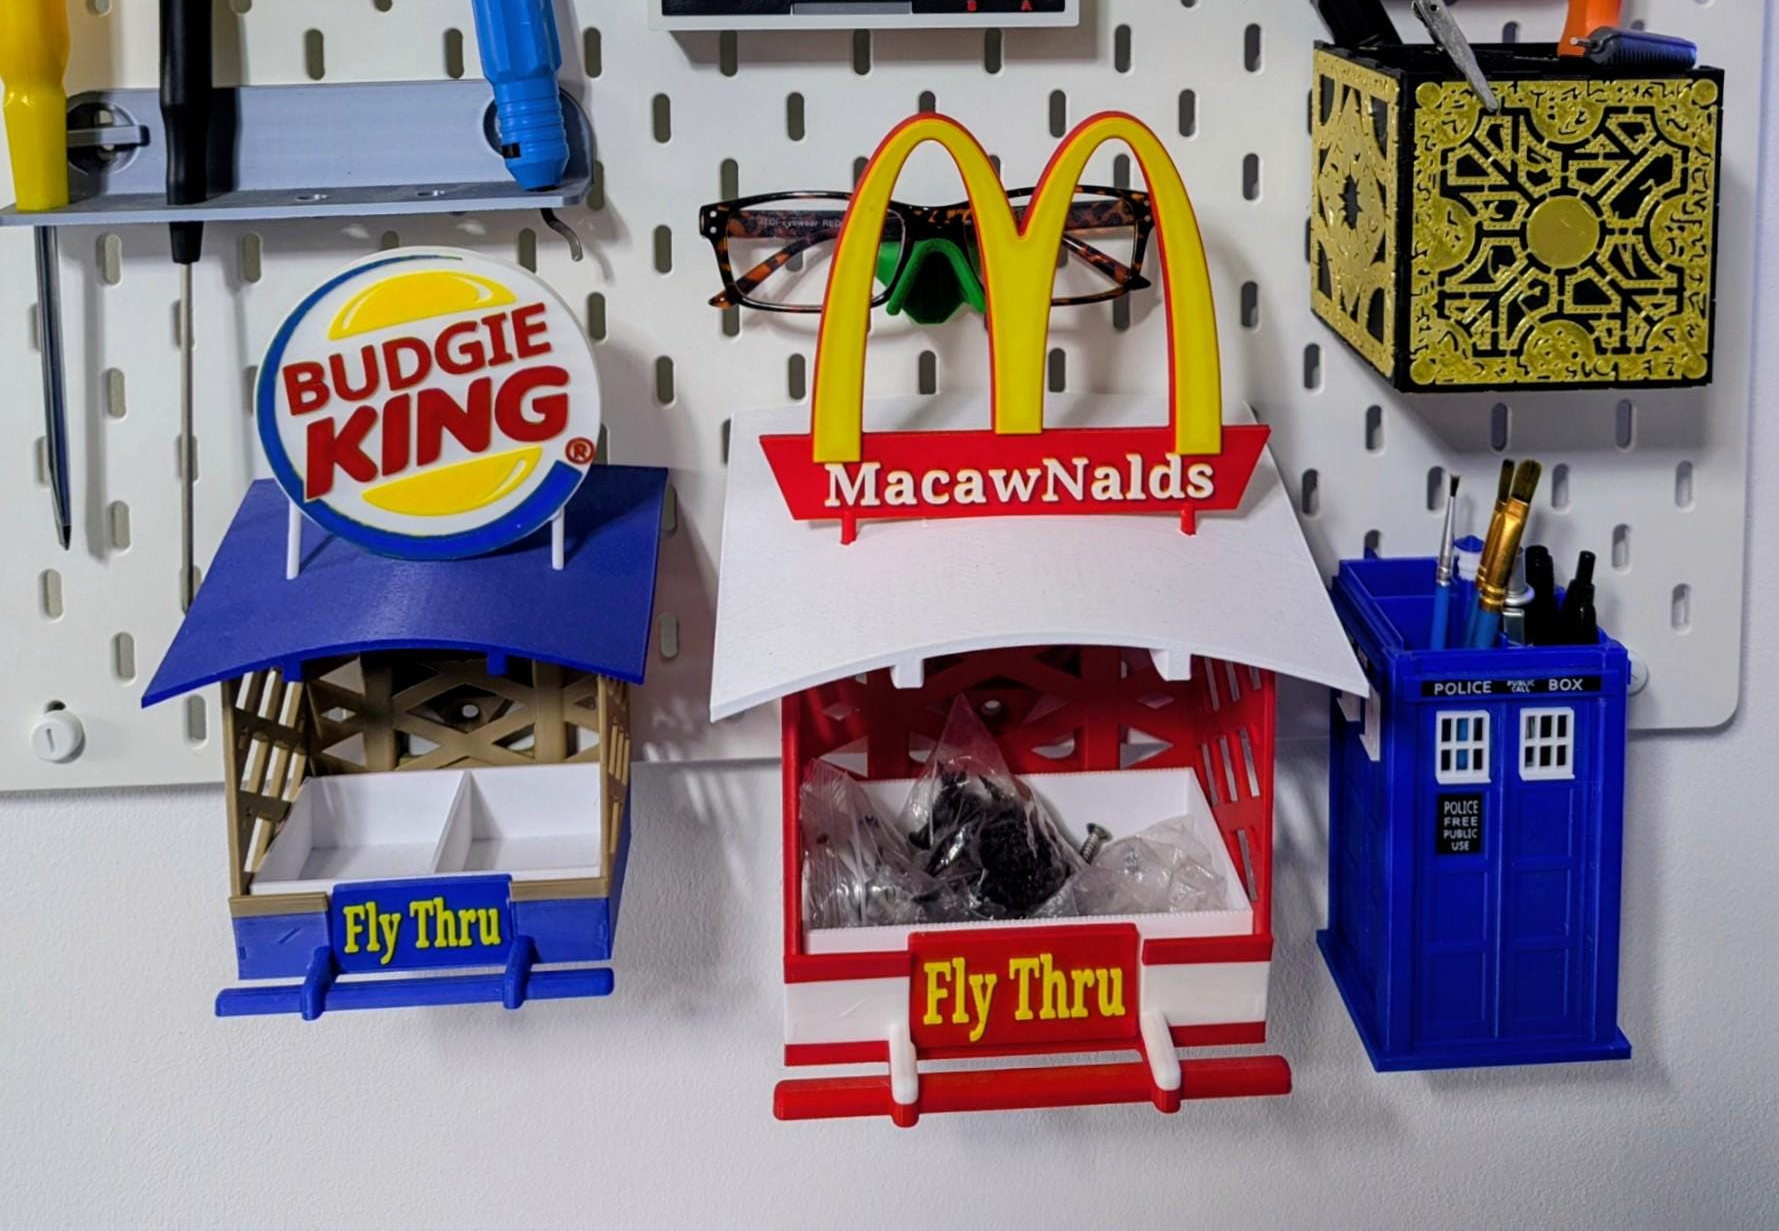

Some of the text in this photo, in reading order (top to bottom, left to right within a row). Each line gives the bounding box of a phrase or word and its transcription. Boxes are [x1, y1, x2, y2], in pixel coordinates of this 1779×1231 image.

[282, 302, 552, 416] BUDGIE
[306, 365, 570, 500] KING
[824, 453, 1215, 508] MacawNalds
[1434, 680, 1493, 696] POLICE
[1548, 678, 1584, 691] BOX
[1443, 800, 1479, 815] POLICE
[1443, 816, 1478, 827] FREE
[1443, 828, 1478, 840] PUBLIC
[1451, 840, 1470, 851] USE
[343, 896, 502, 966] Fly Thru
[923, 953, 1126, 1042] Fly Thru
